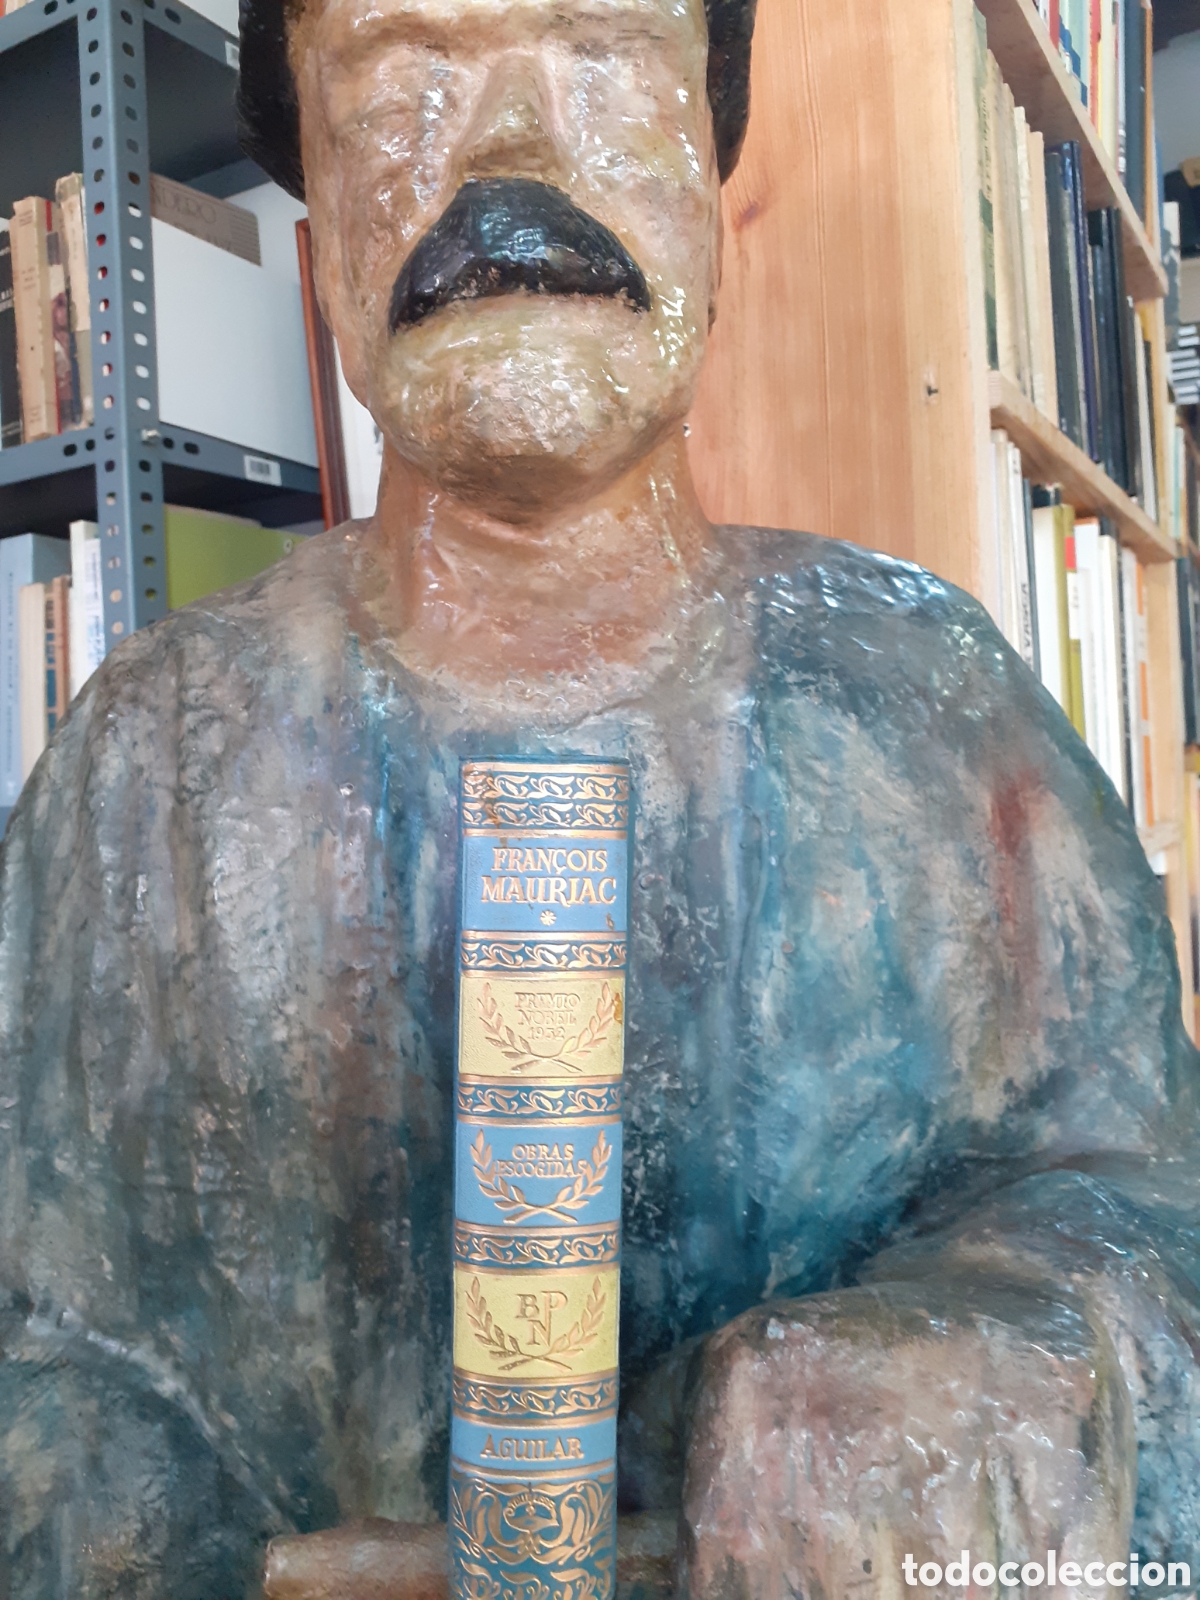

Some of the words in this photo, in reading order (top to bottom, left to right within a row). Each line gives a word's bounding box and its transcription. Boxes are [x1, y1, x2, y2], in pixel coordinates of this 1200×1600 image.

[491, 847, 608, 875] FRANÇOIS
[481, 876, 617, 908] MAURIAC
[514, 992, 581, 1009] PREMIO
[518, 1009, 577, 1026] NOBEL
[528, 1027, 566, 1040] 1952
[511, 1144, 575, 1160] OBRAS
[495, 1159, 590, 1178] ESCOGIDAS
[480, 1433, 585, 1461] AGUILAR
